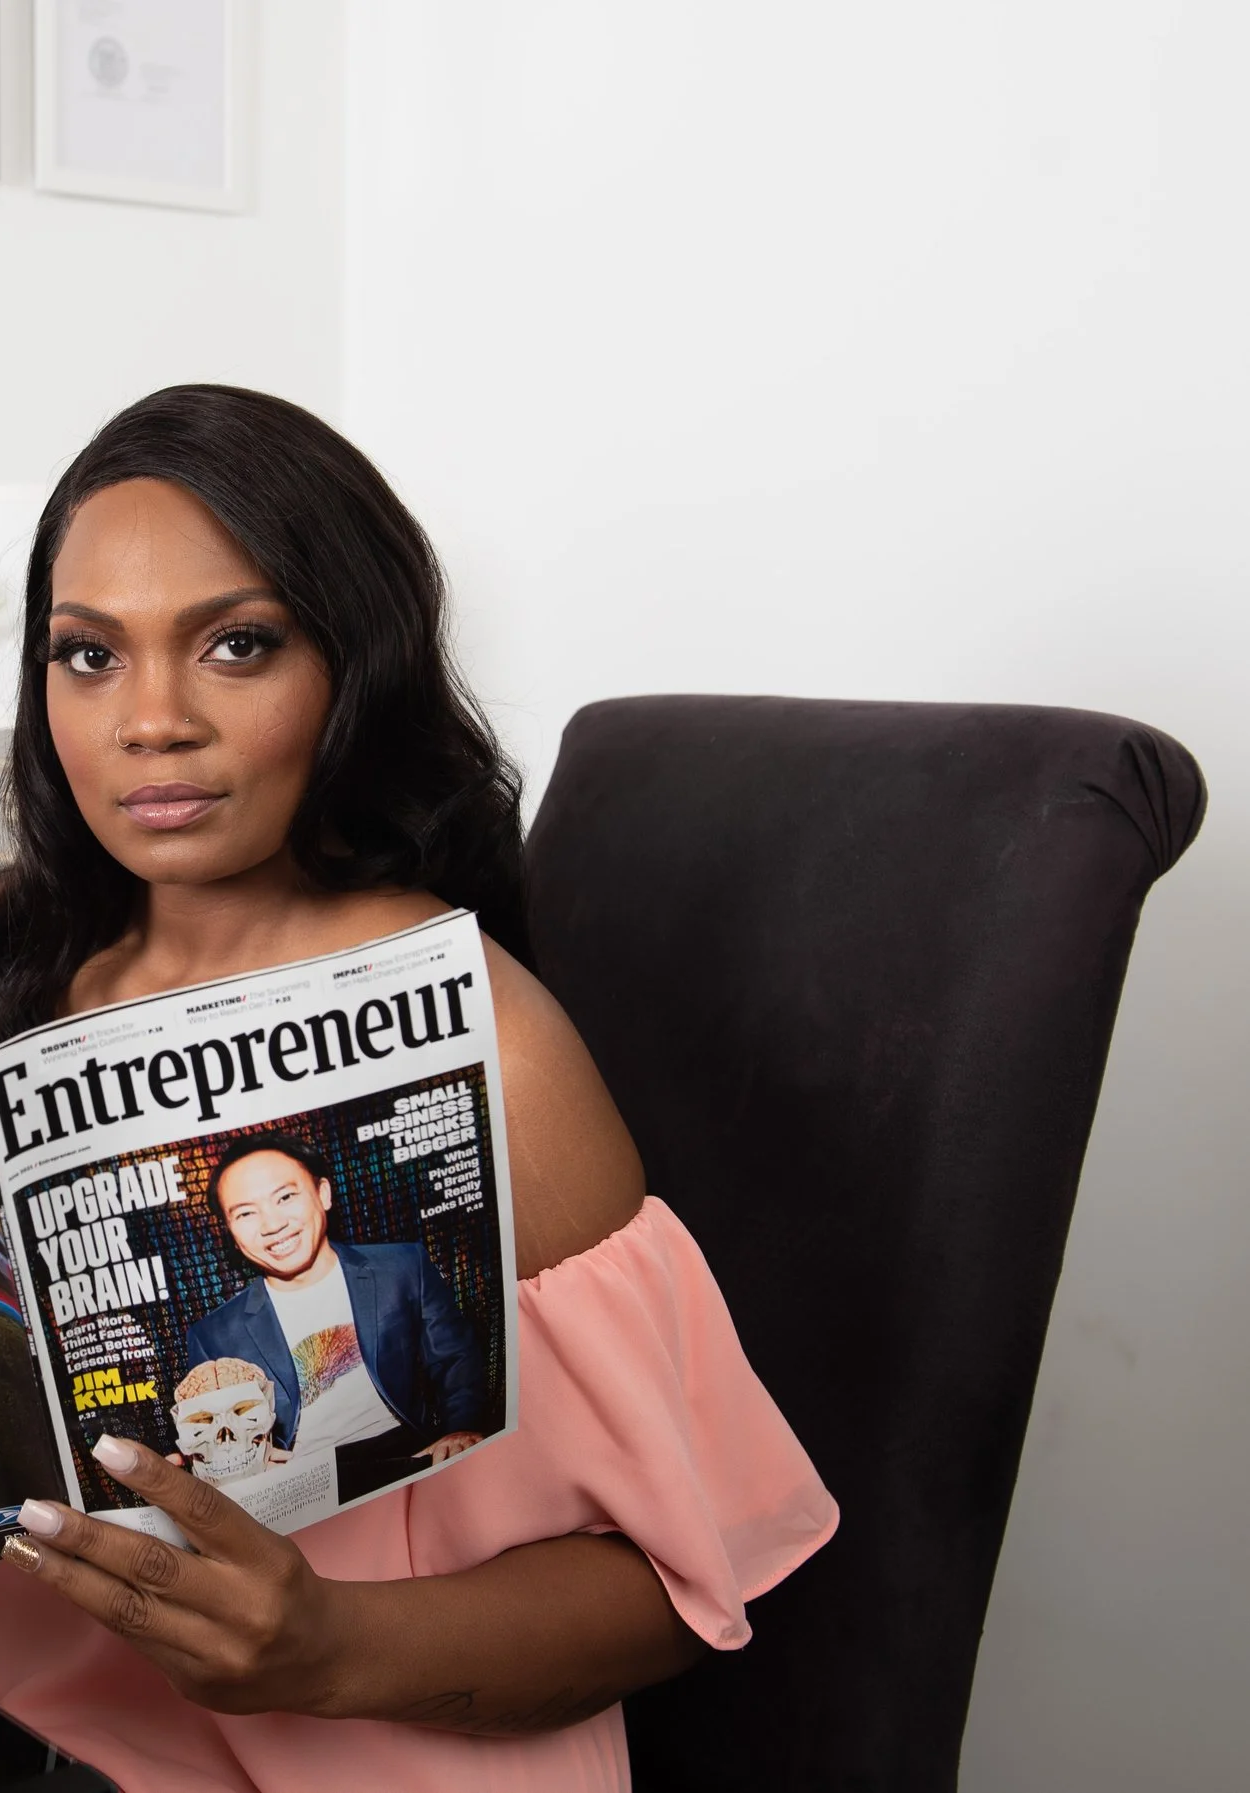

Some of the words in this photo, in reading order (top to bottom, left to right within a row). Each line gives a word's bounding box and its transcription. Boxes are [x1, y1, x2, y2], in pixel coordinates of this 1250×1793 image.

[333, 962, 373, 980] IMPACT/
[186, 994, 247, 1015] MARKETING/
[40, 1035, 87, 1055] GROWTH/
[393, 1080, 472, 1115] SMALL
[356, 1095, 474, 1143] BUSINESS
[388, 1110, 475, 1148] THINKS
[392, 1125, 477, 1164] BIGGER
[443, 1145, 479, 1164] What
[428, 1157, 480, 1181] Pivoting
[434, 1181, 442, 1191] a
[443, 1167, 481, 1188] Brand
[26, 1154, 187, 1239] UPGRADE
[443, 1179, 482, 1200] Really
[420, 1200, 457, 1219] Looks
[458, 1191, 483, 1206] Like
[36, 1217, 133, 1282] YOUR
[48, 1255, 169, 1327] BRAIN!
[59, 1323, 96, 1341] Learn
[97, 1313, 136, 1329] More.
[62, 1333, 98, 1352] Think
[99, 1324, 145, 1340] Faster.
[64, 1344, 103, 1363] Focus
[105, 1336, 151, 1350] Better.
[66, 1352, 121, 1375] Lessons
[122, 1347, 155, 1361] from
[73, 1367, 122, 1395] JIM
[74, 1380, 158, 1412] KWIK
[78, 1411, 97, 1421] P.32
